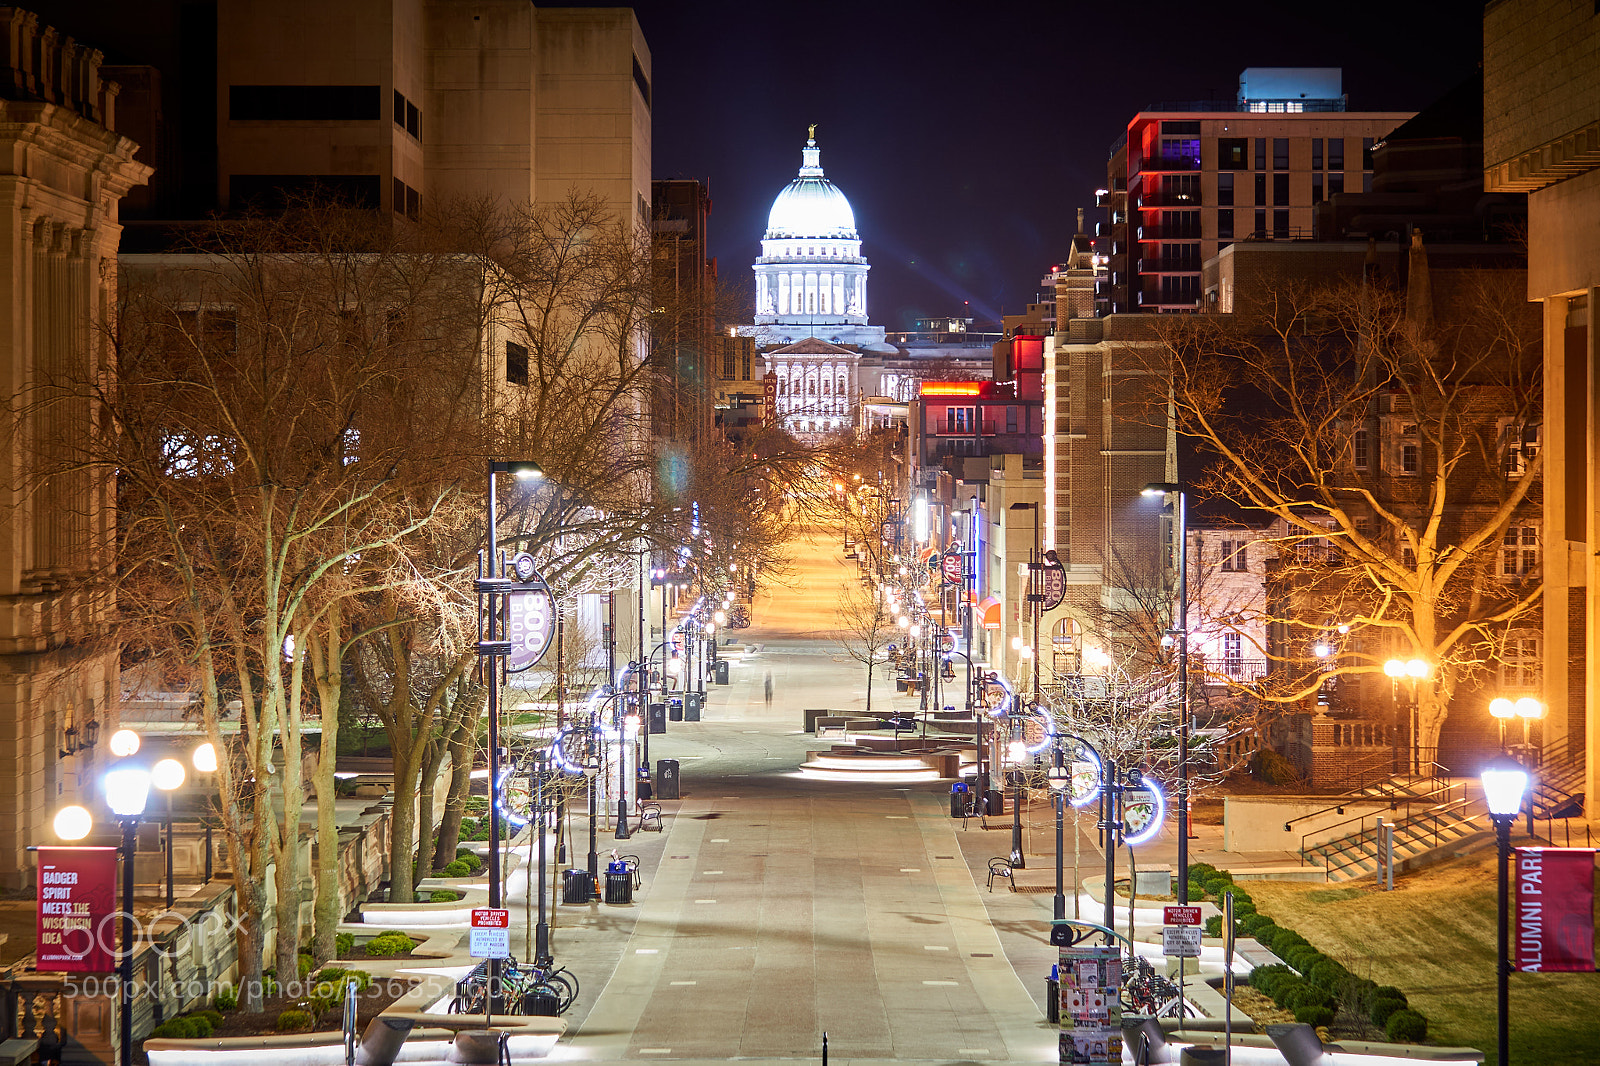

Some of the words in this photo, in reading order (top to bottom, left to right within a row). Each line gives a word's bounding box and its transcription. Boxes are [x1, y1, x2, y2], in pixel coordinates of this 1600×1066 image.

[945, 556, 956, 578] 700
[1051, 569, 1062, 601] 800
[511, 603, 524, 652] BLOCK
[523, 591, 545, 652] 800
[43, 872, 78, 885] BADGER
[1521, 850, 1542, 894] PARK
[42, 887, 72, 900] SPIRIT
[42, 902, 72, 915] MEETS
[73, 902, 90, 915] THE
[42, 917, 92, 930] WISCONSIN
[42, 932, 62, 945] IDEA
[1521, 902, 1542, 972] ALUMNI
